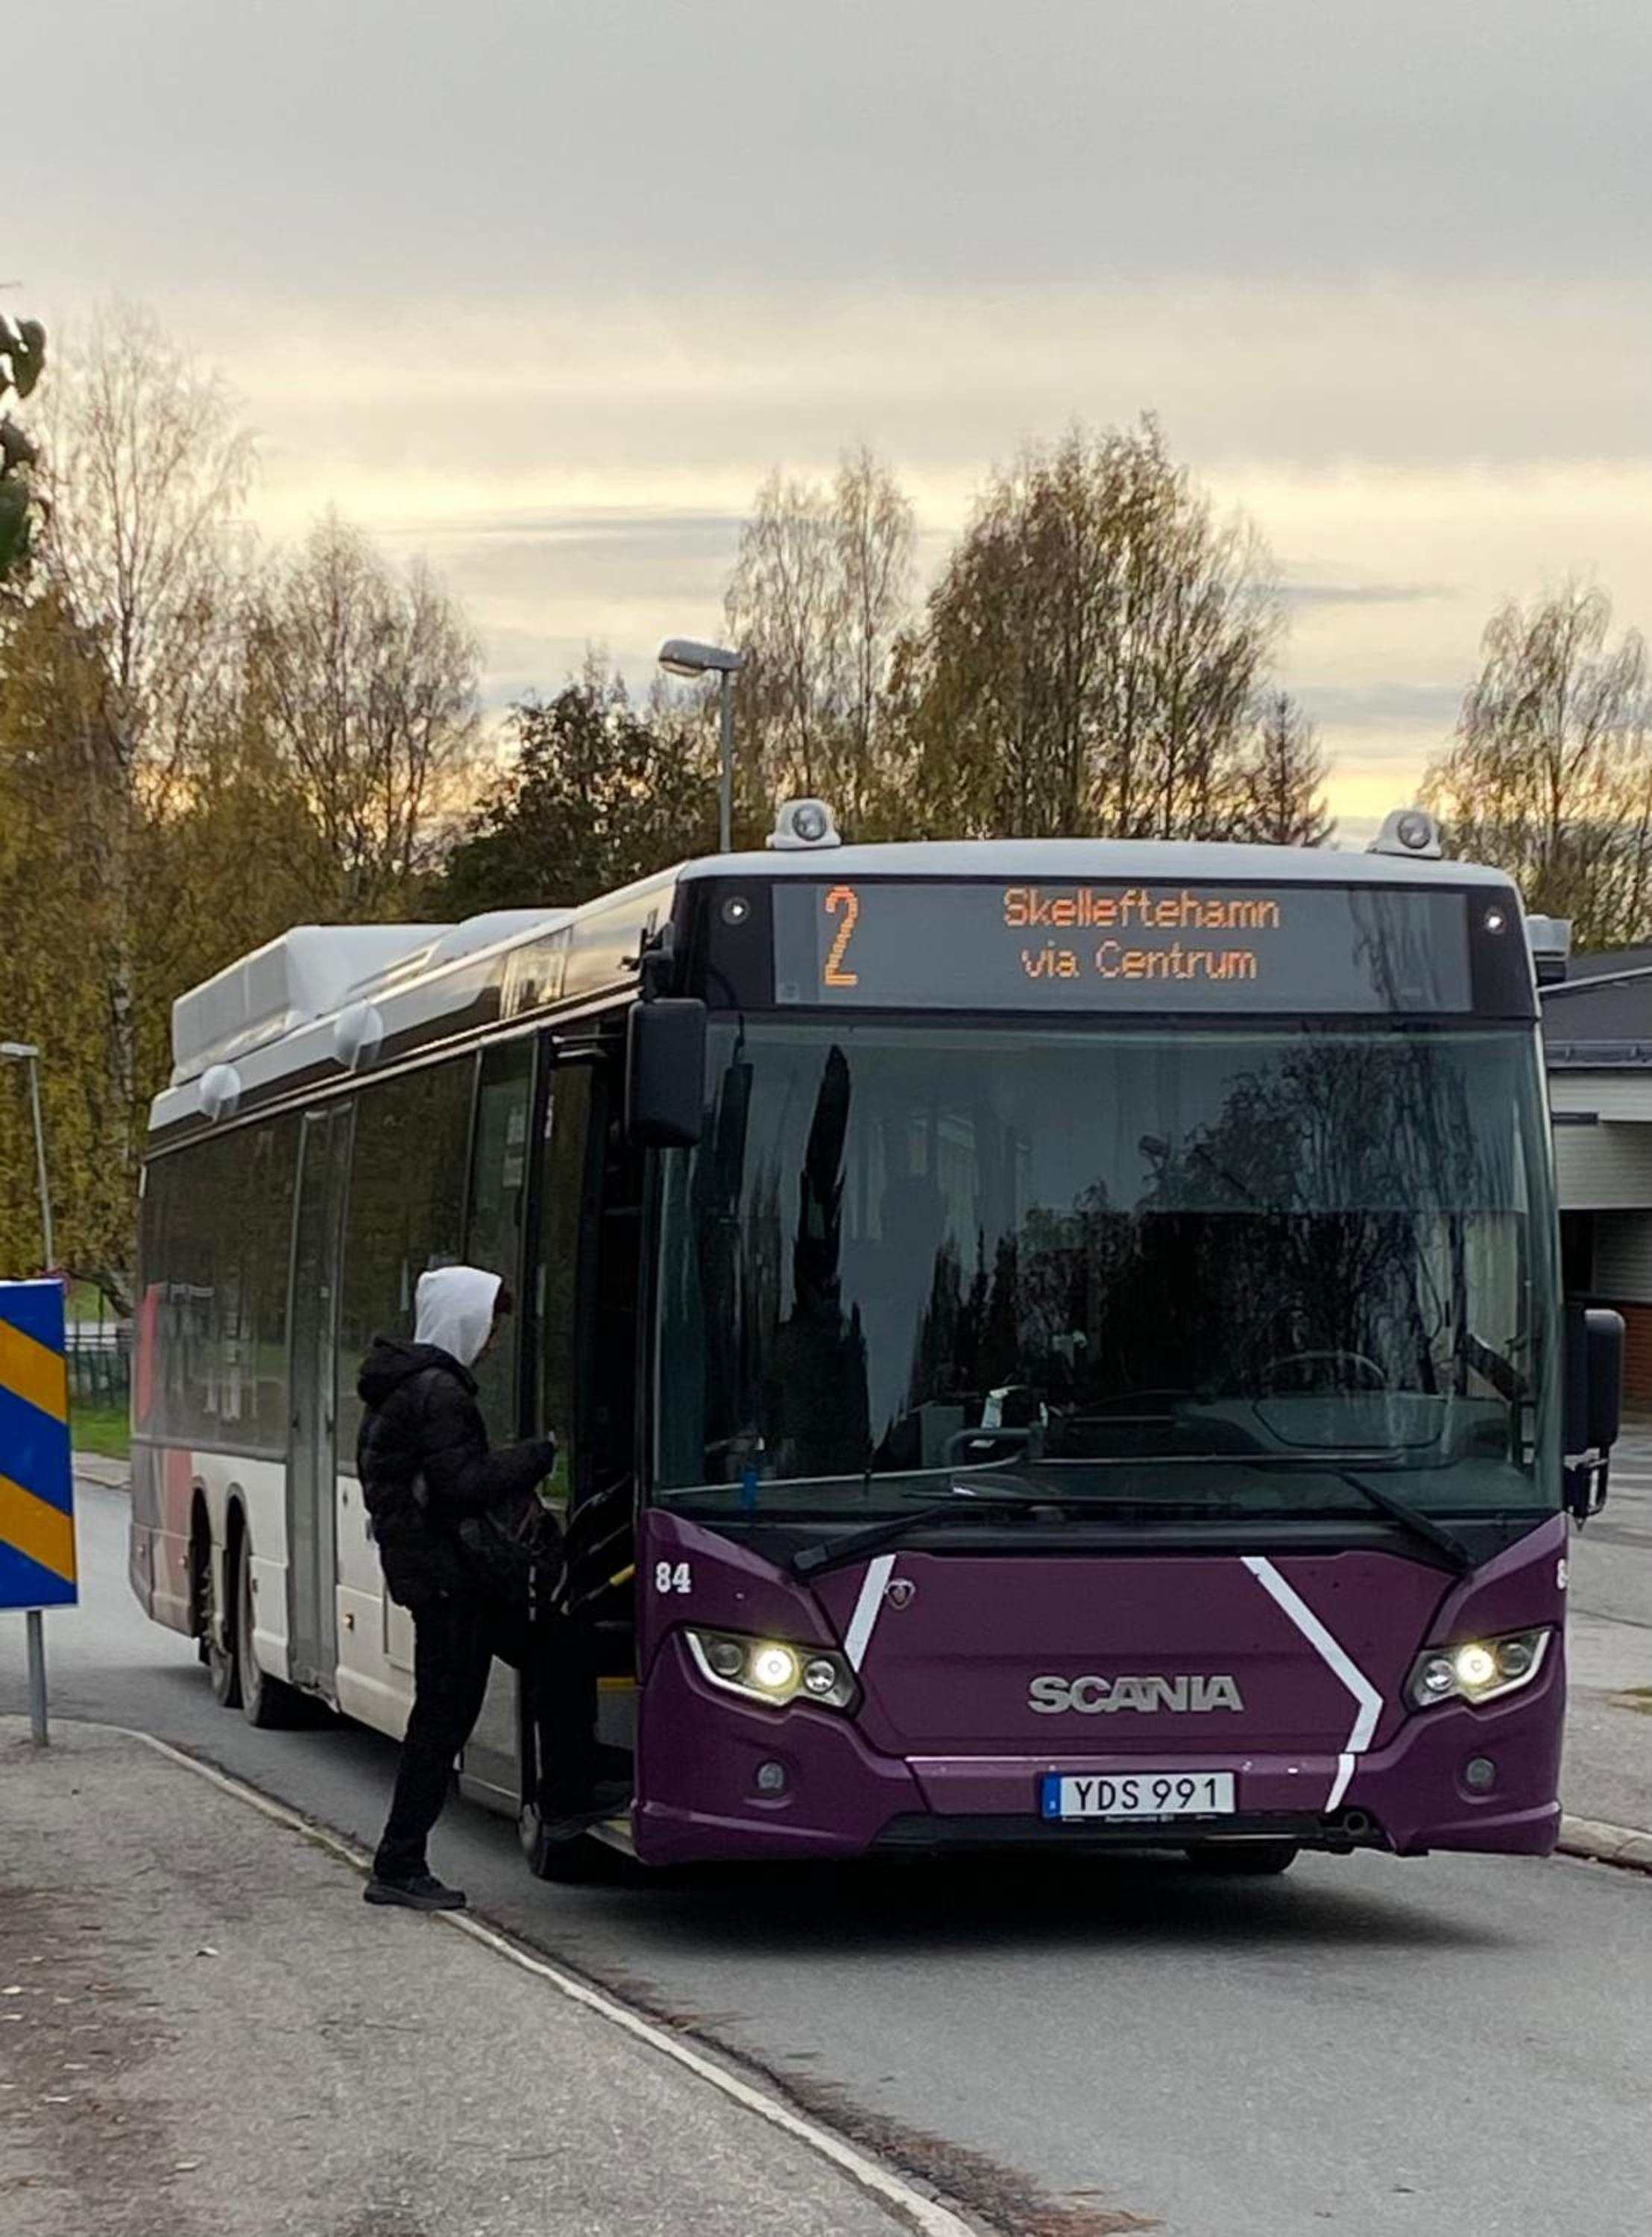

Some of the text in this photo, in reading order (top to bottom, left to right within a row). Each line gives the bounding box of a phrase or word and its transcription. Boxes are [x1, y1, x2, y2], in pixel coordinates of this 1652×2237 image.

[1003, 887, 1281, 928] Skelleftehamn
[825, 886, 858, 986] 2
[1021, 940, 1258, 980] via Centrum
[656, 1561, 692, 1593] 84
[1027, 1676, 1244, 1713] SCANIA
[1074, 1778, 1217, 1810] YDS 991
